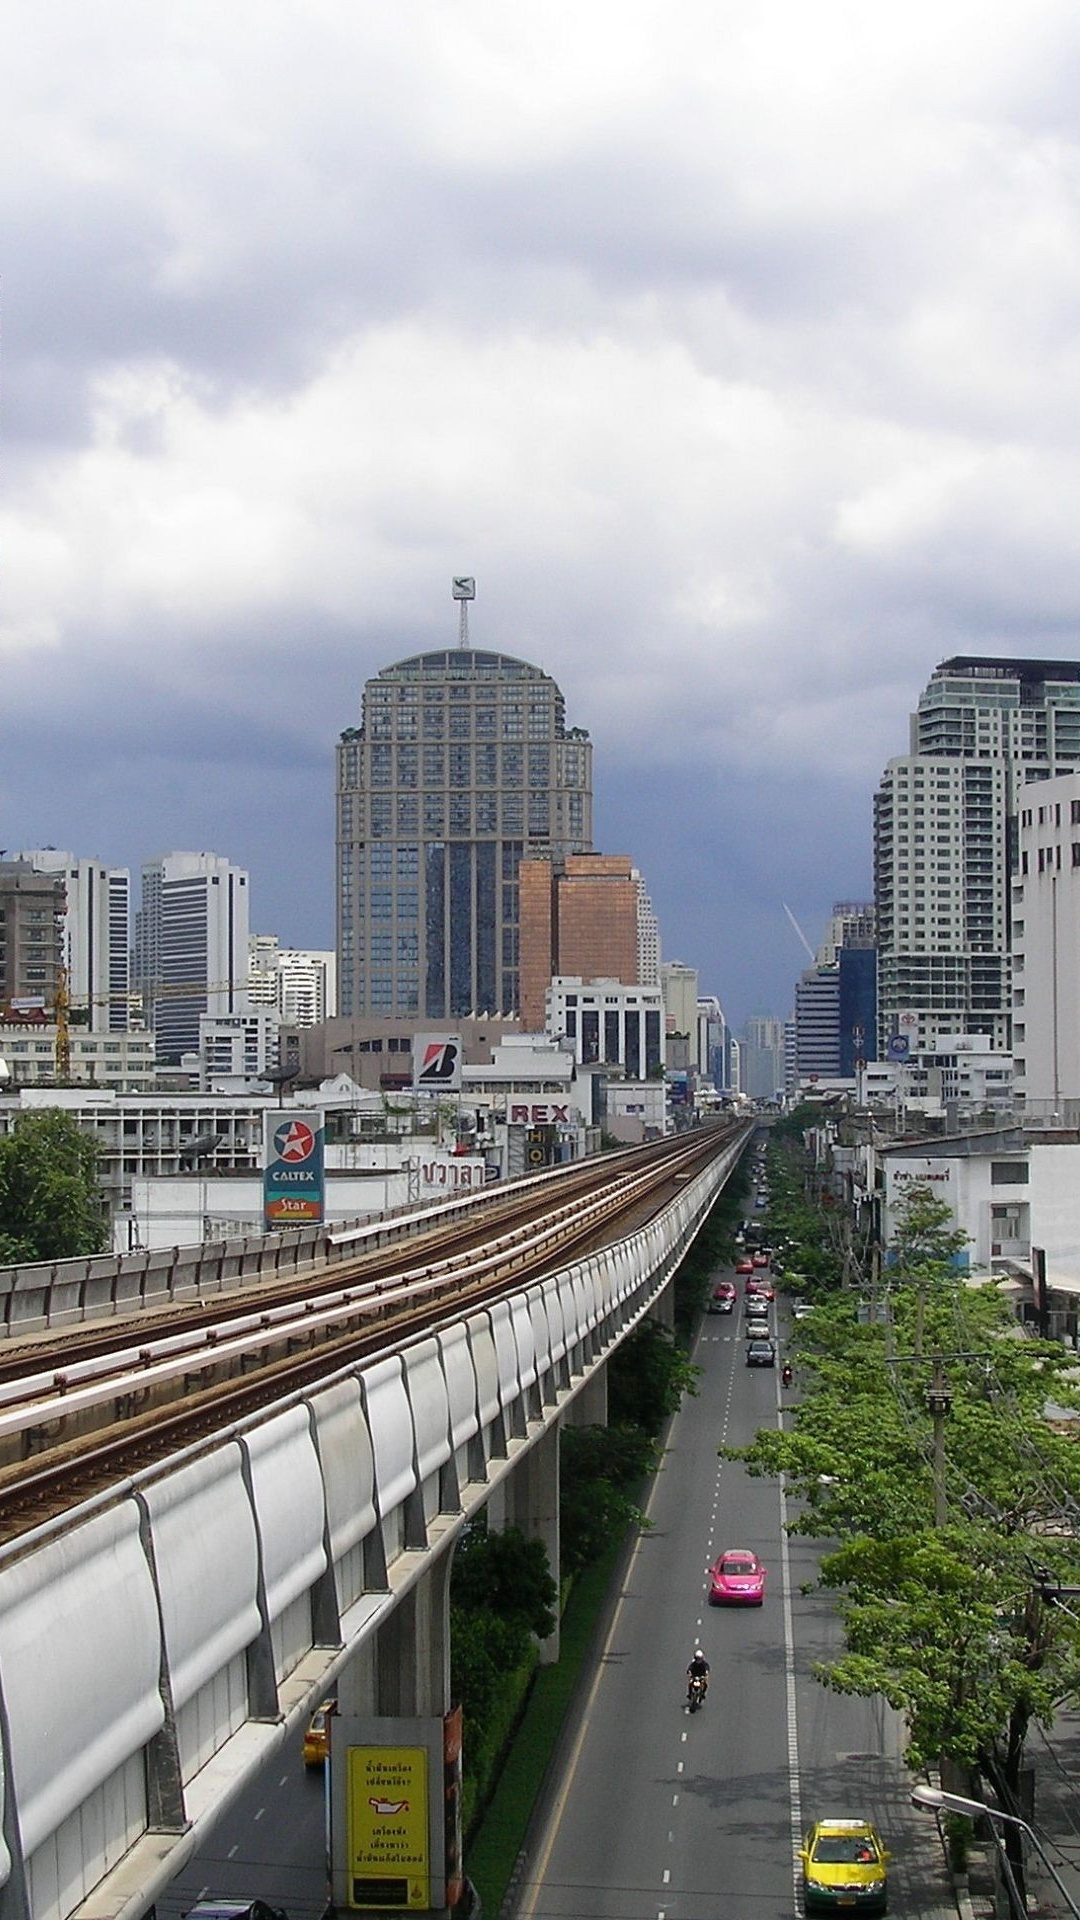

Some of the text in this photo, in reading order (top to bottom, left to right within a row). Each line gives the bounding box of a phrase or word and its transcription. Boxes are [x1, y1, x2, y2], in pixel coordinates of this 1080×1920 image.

[511, 1104, 569, 1123] REX
[272, 1171, 315, 1181] CALTEX
[281, 1198, 307, 1212] Star
